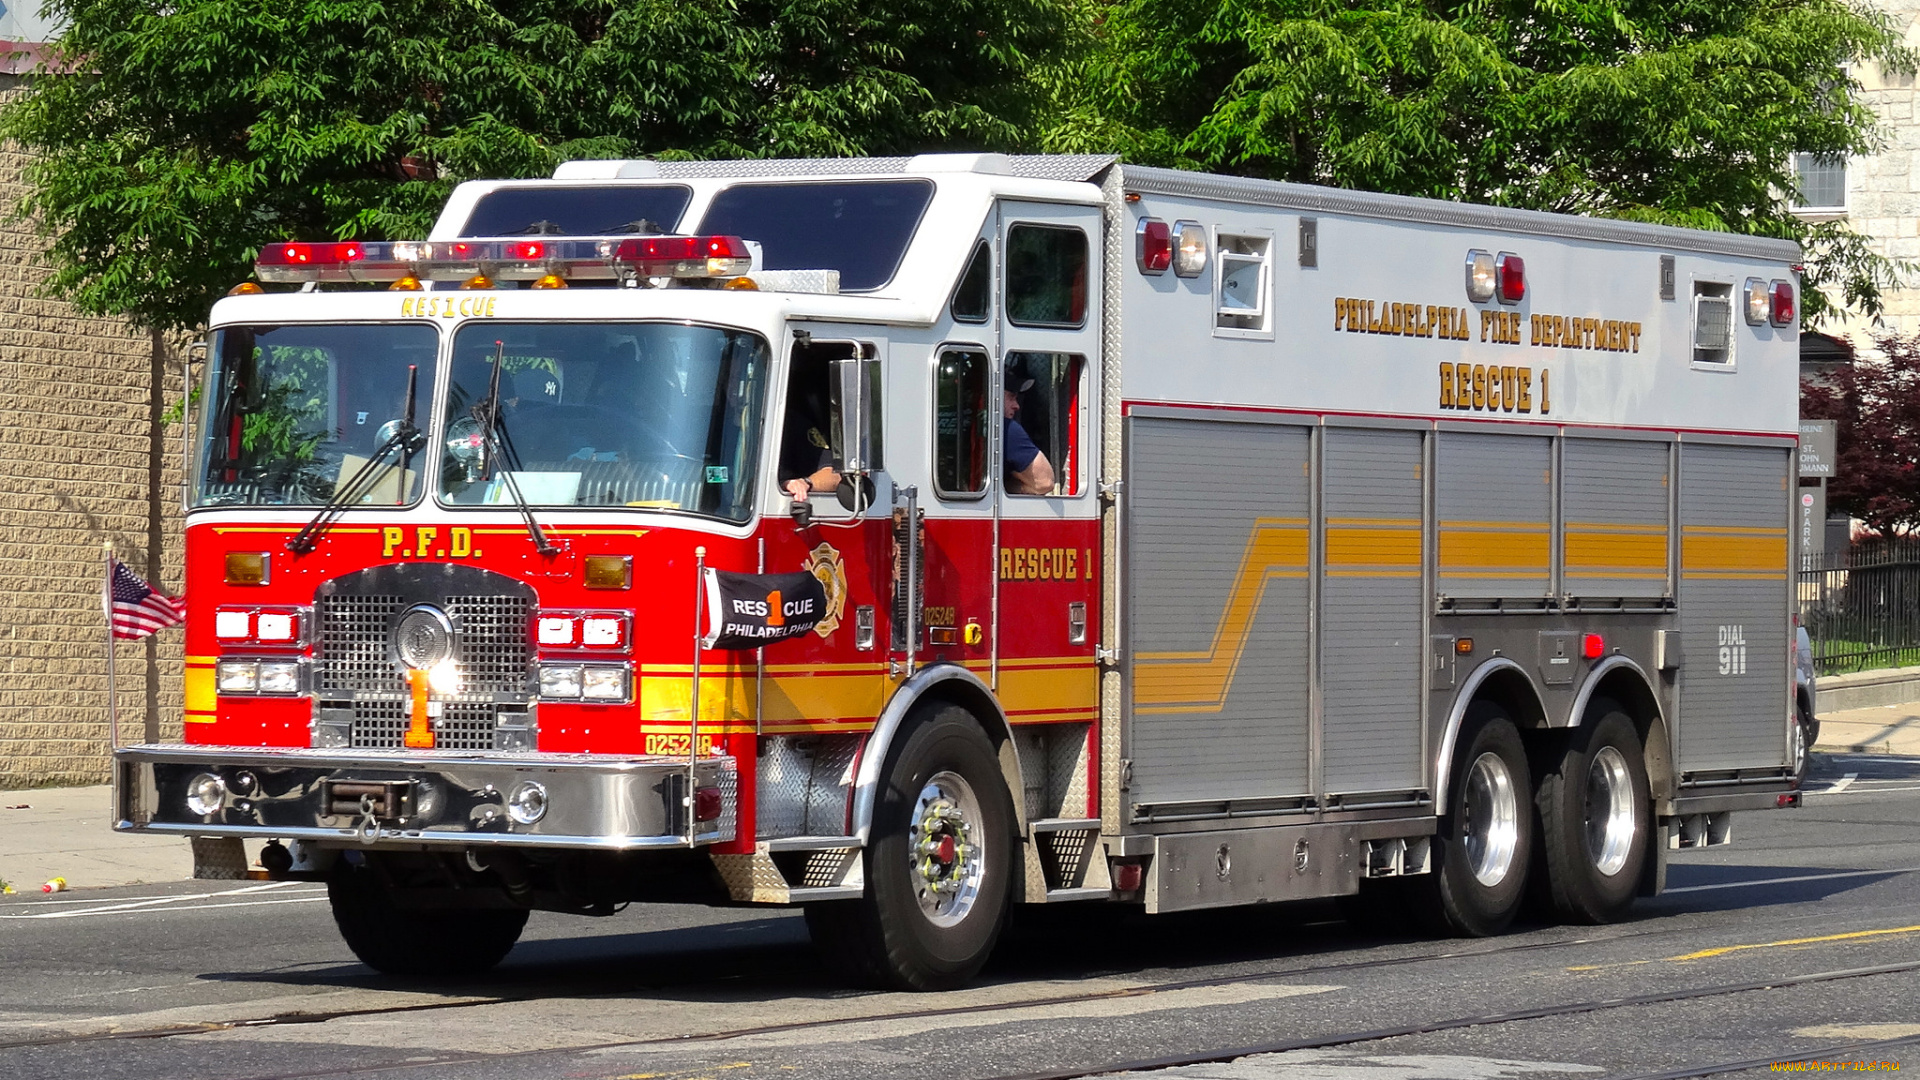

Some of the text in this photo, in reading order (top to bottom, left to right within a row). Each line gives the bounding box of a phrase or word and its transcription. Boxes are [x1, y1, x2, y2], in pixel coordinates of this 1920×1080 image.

[1335, 297, 1641, 353] PHILADELPHIA FIRE DEPARTMENT
[1439, 361, 1550, 414] RESCUE 1
[1799, 425, 1823, 433] HRINE
[1800, 454, 1819, 462] OHN
[1803, 445, 1815, 453] ST.
[382, 527, 482, 559] P.F.D.
[1000, 548, 1093, 581] RESCUE 1
[725, 621, 814, 638] PHILADELPHIA
[1719, 625, 1746, 645] DIAL
[1719, 646, 1746, 675] 911
